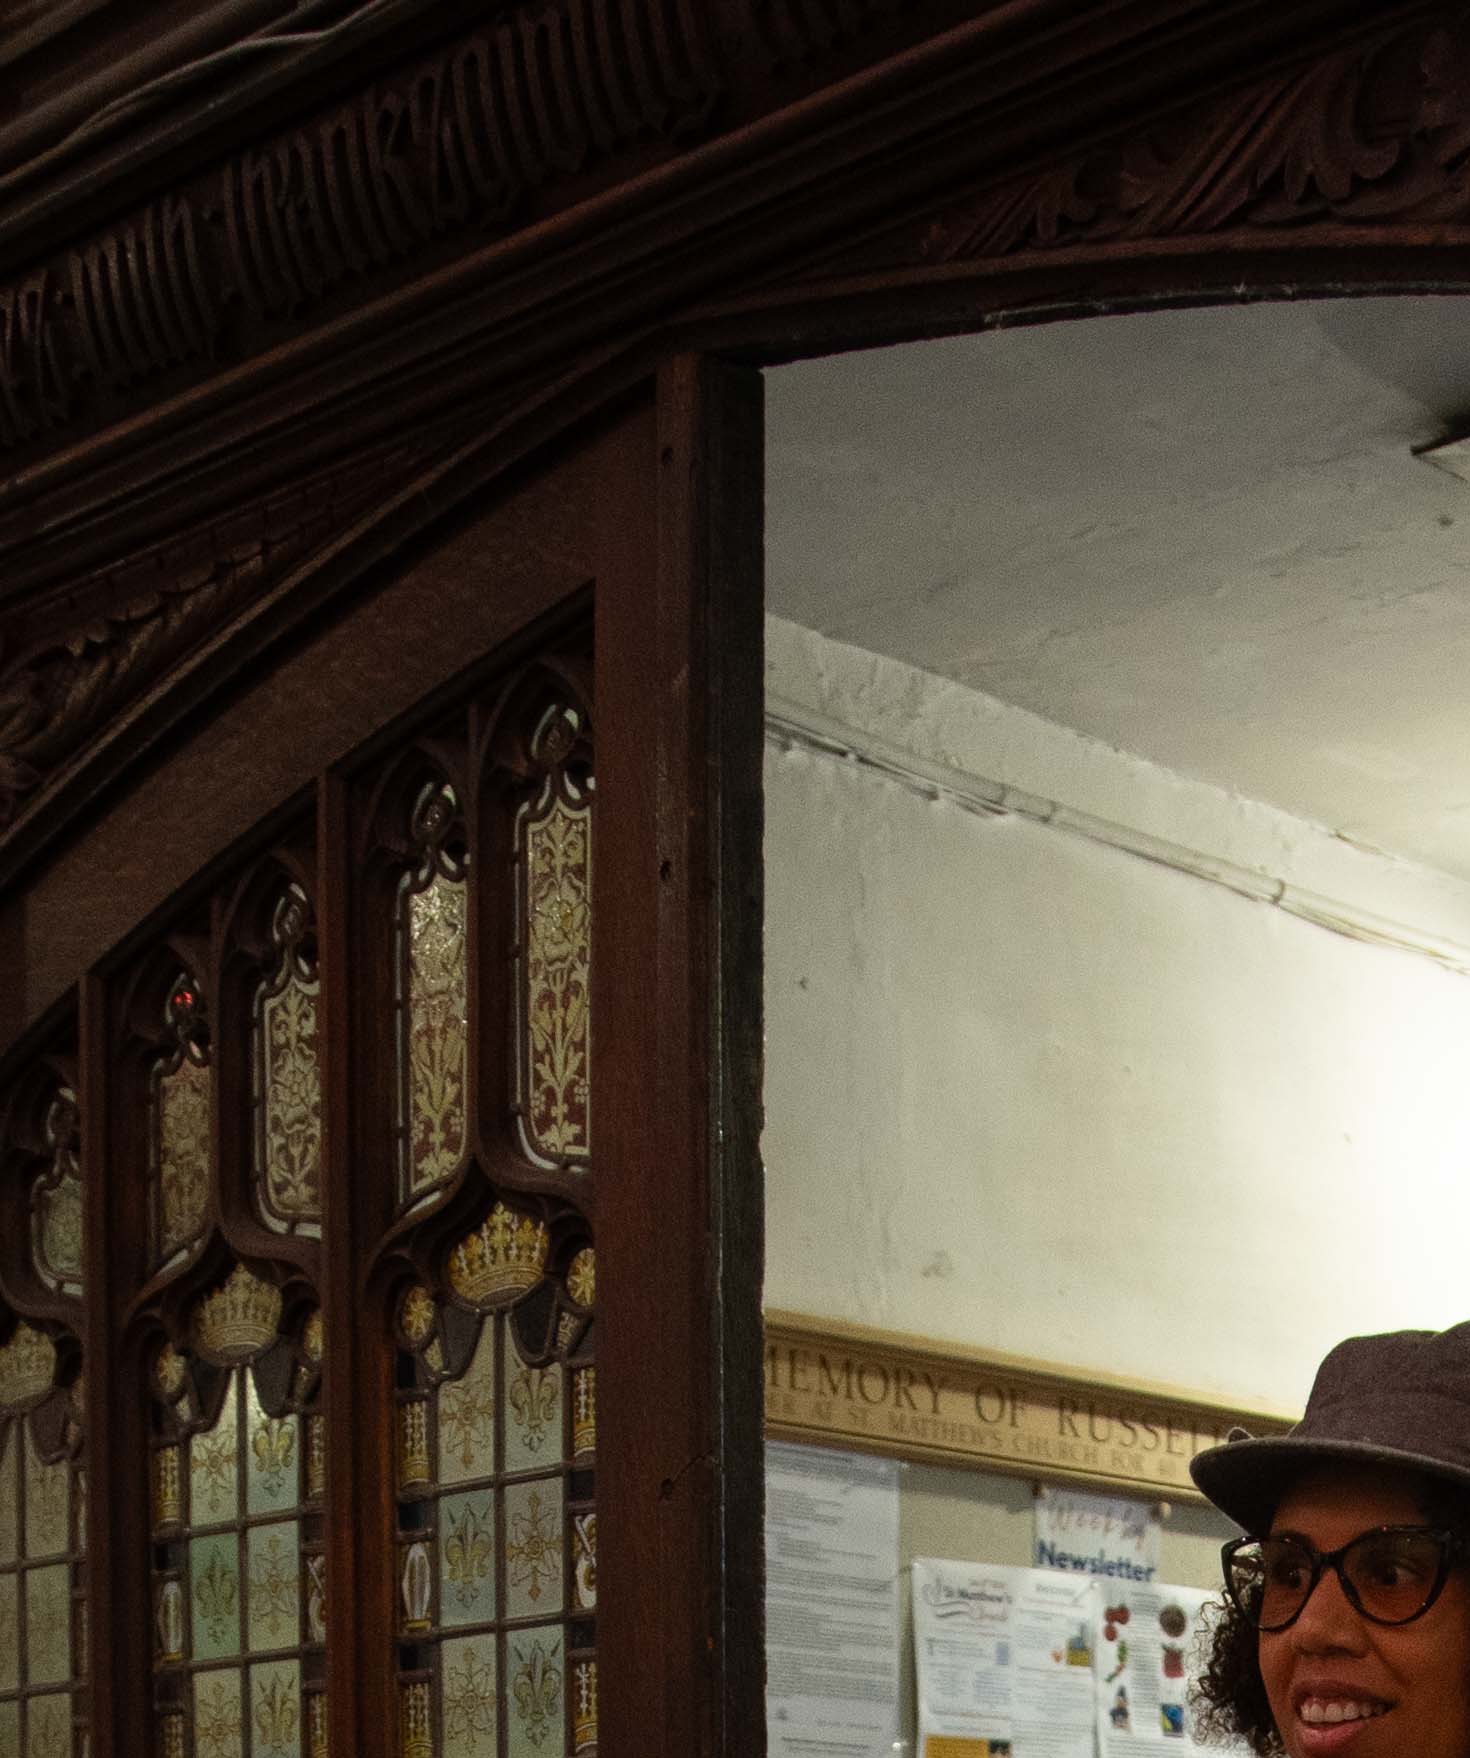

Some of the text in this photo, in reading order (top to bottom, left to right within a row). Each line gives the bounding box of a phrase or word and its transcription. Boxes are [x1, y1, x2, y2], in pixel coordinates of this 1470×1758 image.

[974, 1383, 1025, 1428] OF
[1012, 1432, 1100, 1466] CHURCH
[1036, 1540, 1155, 1582] Newsletter
